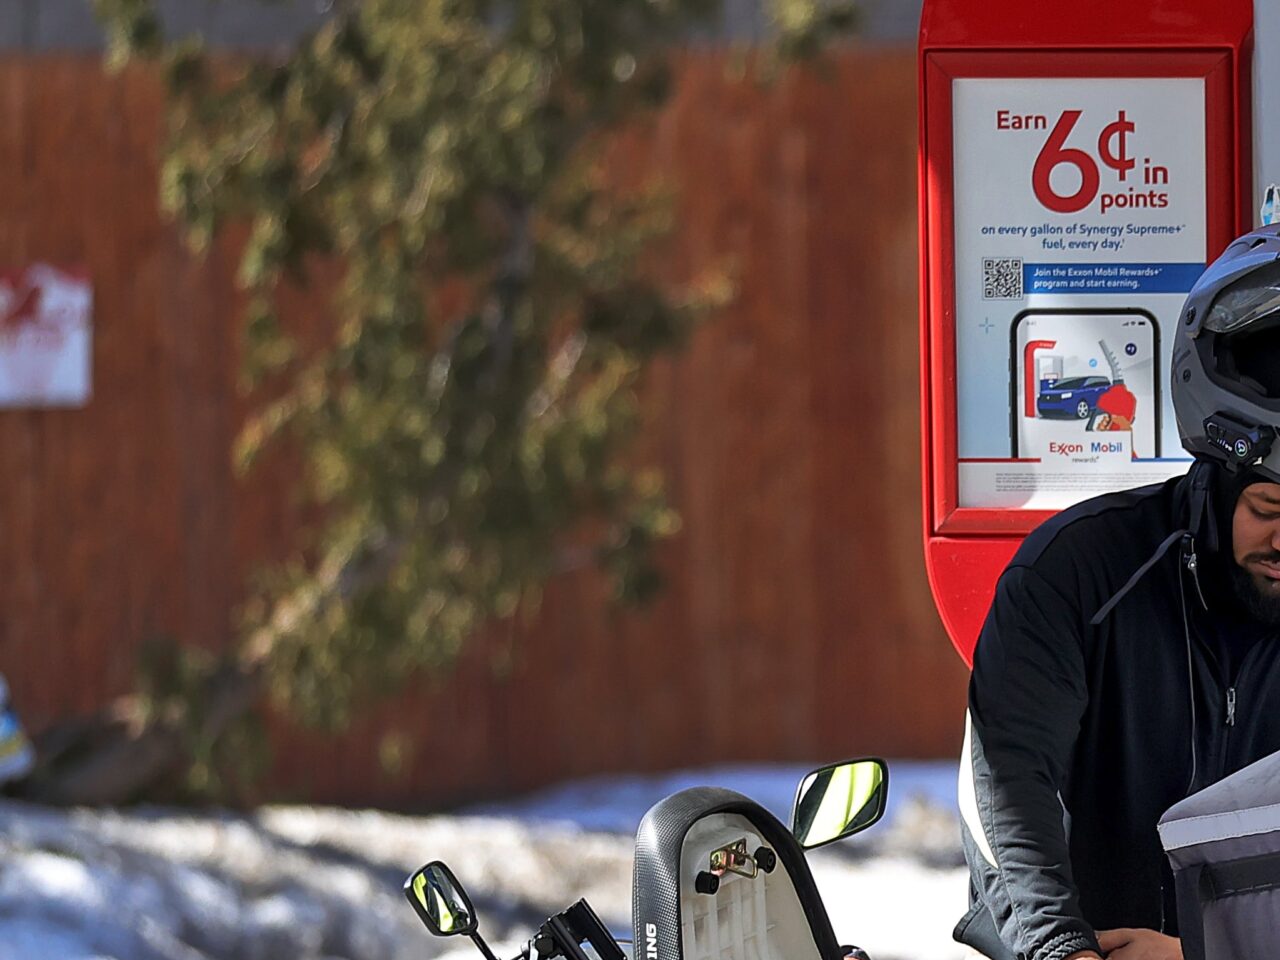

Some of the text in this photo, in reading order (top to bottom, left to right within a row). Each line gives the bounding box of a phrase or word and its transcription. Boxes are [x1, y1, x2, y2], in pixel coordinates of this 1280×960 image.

[996, 110, 1047, 130] Earn
[1144, 158, 1168, 185] in
[1100, 187, 1169, 214] points
[981, 226, 996, 235] on
[998, 226, 1028, 238] every
[1030, 223, 1063, 238] gallon
[1065, 223, 1077, 235] of
[1079, 224, 1124, 238] Synergy
[1068, 240, 1099, 251] every
[1033, 268, 1052, 277] Join
[1053, 268, 1066, 277] the
[1068, 268, 1093, 277] Exxon
[1095, 268, 1118, 277] Mobil
[1033, 279, 1069, 290] program
[1071, 278, 1085, 288] and
[1086, 279, 1104, 288] start
[1049, 442, 1123, 456] Exxon Mobil
